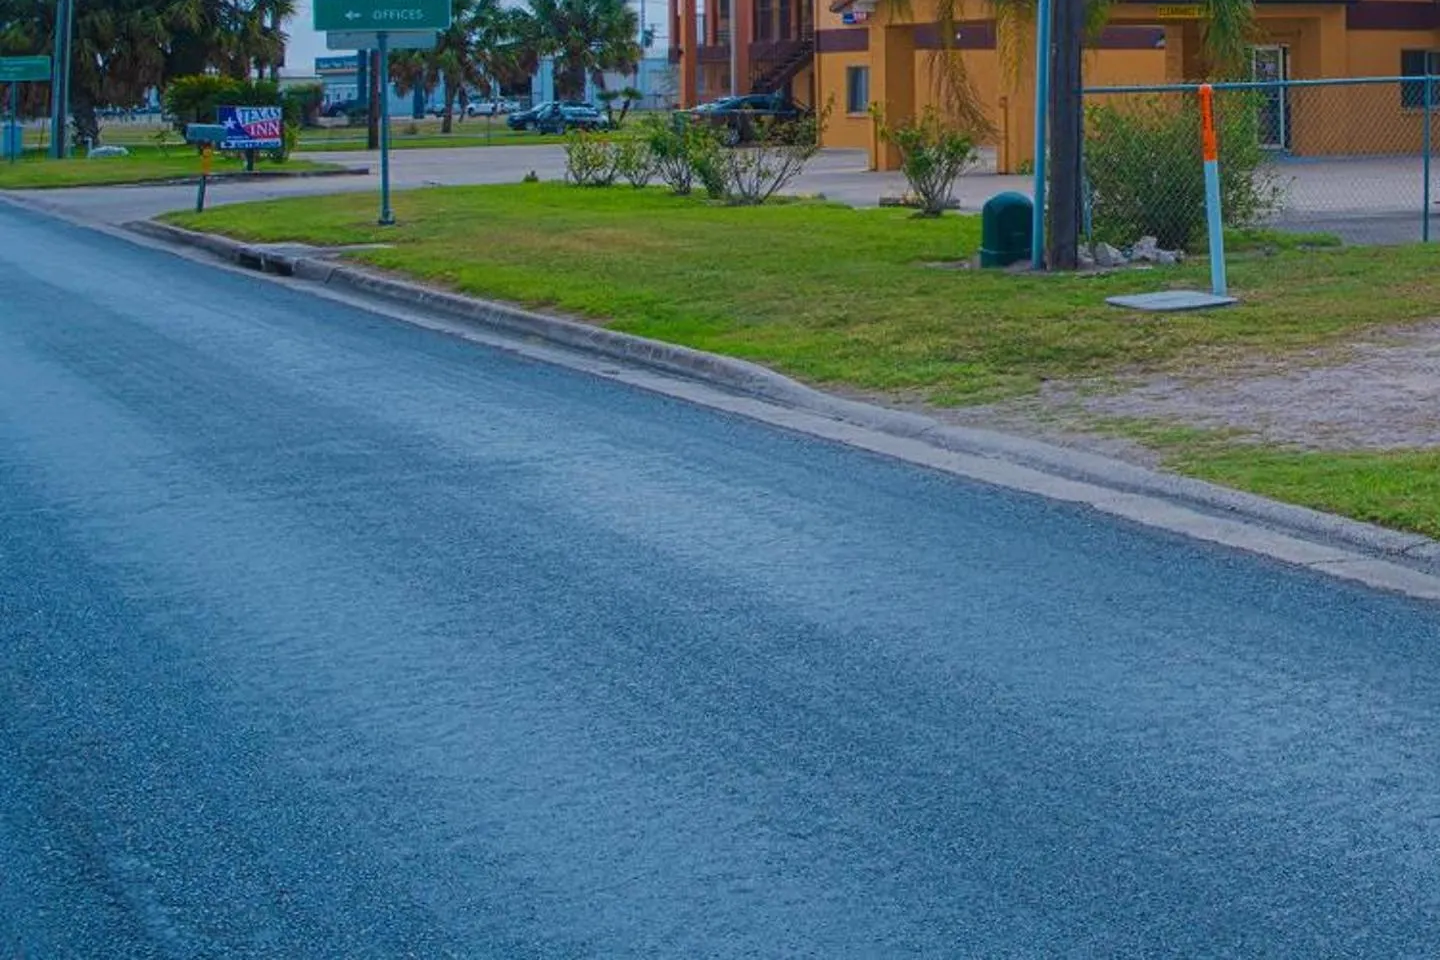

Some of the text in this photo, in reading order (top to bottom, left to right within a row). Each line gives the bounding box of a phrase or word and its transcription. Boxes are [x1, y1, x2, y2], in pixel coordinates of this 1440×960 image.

[372, 8, 424, 20] OFFICES
[240, 108, 280, 125] TEXAS
[250, 121, 280, 137] INN
